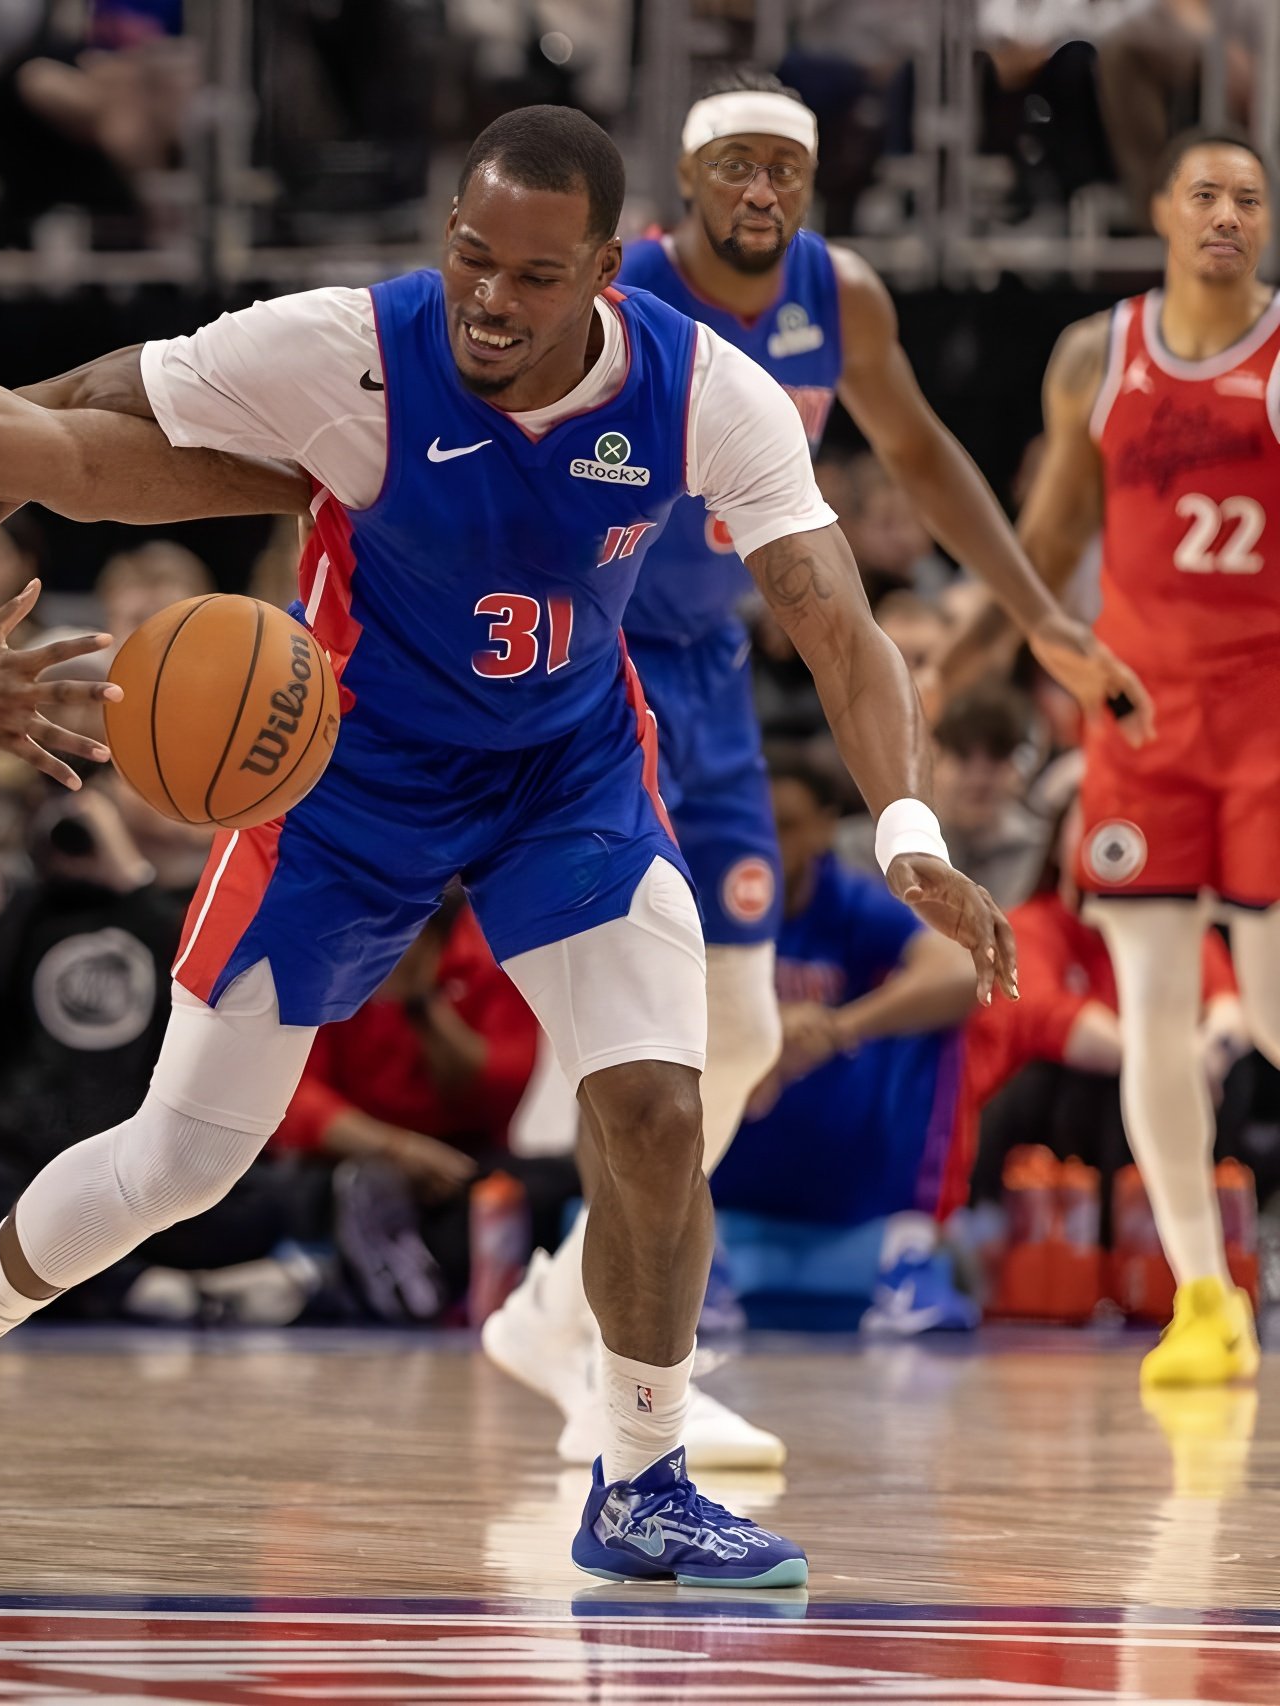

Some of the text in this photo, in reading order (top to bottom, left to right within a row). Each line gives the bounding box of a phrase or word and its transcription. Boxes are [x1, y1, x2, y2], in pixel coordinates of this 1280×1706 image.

[572, 461, 647, 483] StockX
[1173, 492, 1266, 574] 22
[471, 592, 574, 679] 31
[239, 633, 312, 776] Wilson
